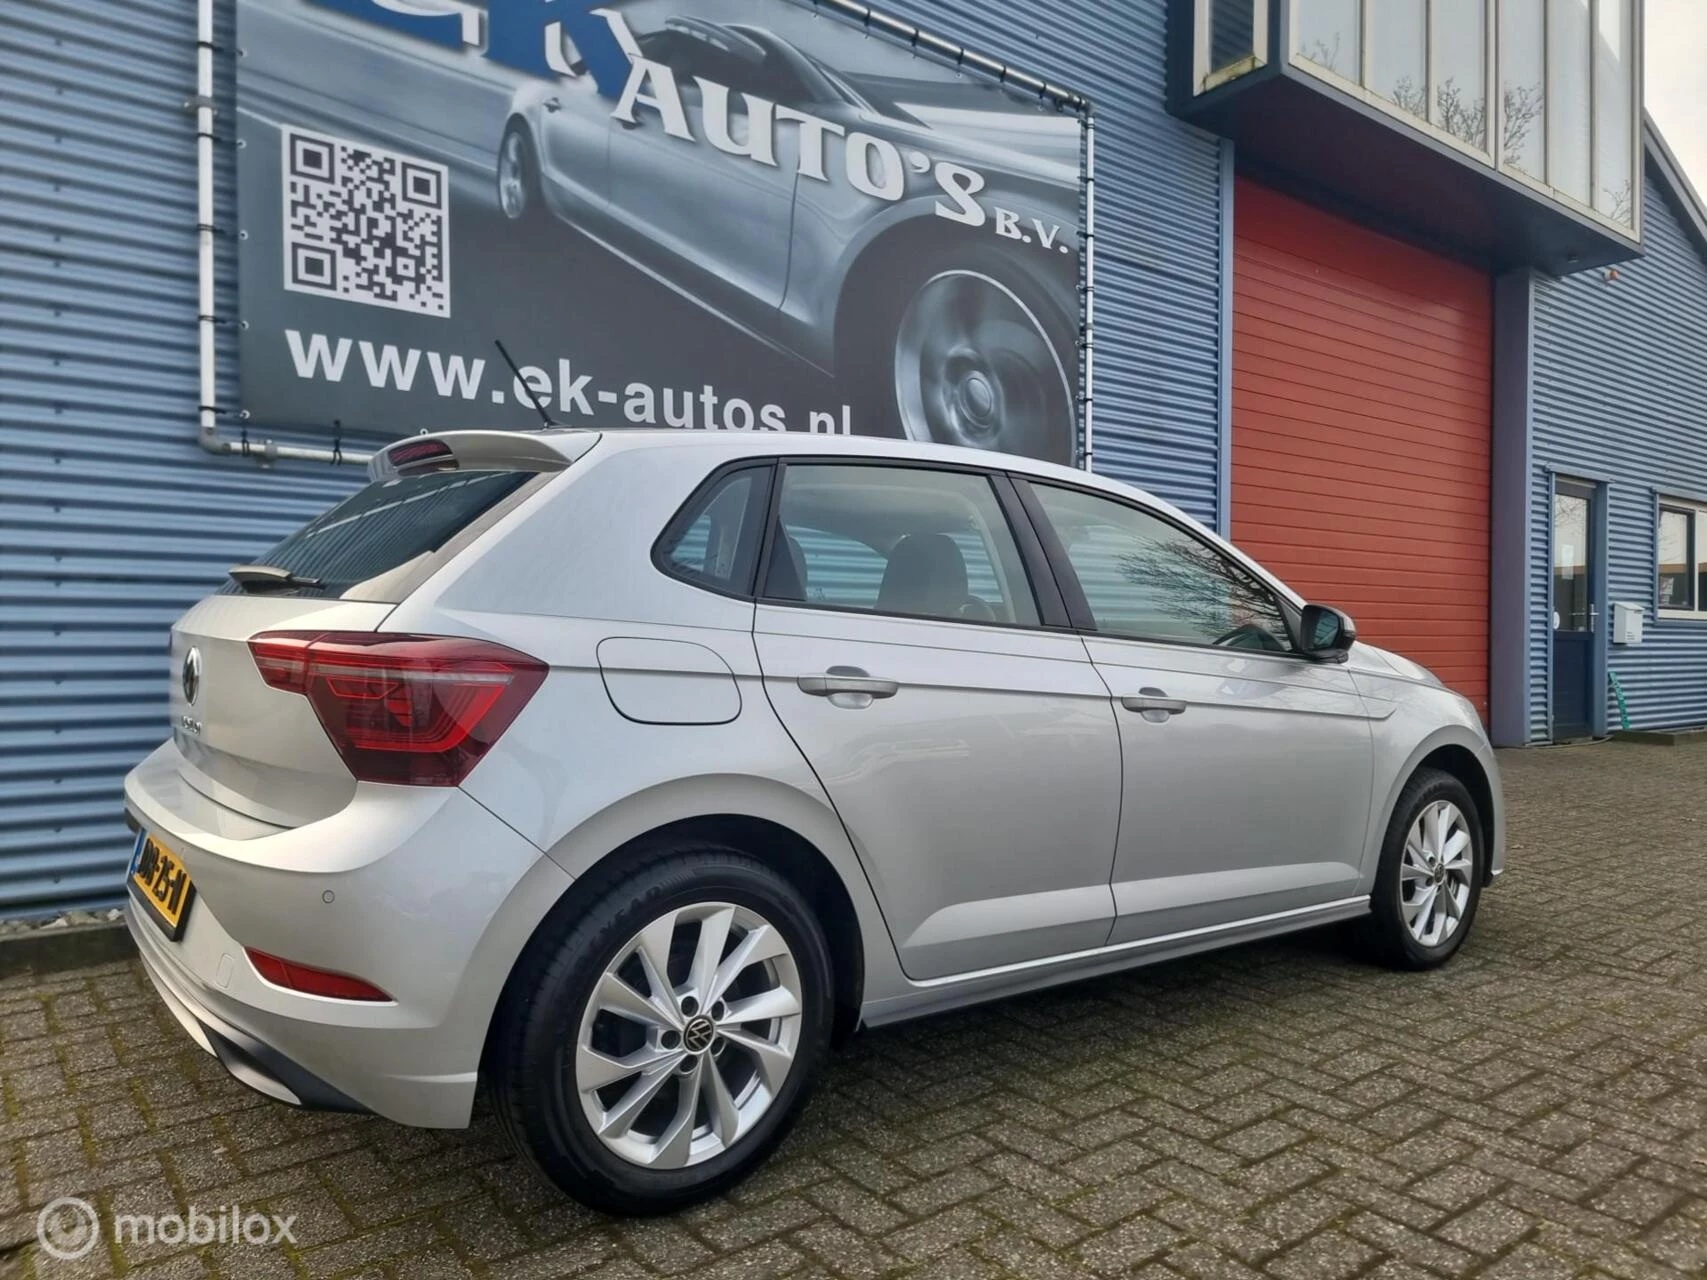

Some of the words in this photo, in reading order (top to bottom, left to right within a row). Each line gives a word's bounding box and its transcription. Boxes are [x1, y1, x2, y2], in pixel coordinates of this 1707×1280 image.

[610, 54, 985, 227] AUTO'S
[993, 206, 1069, 254] B.V.
[285, 329, 851, 435] www.ek-autosnl
